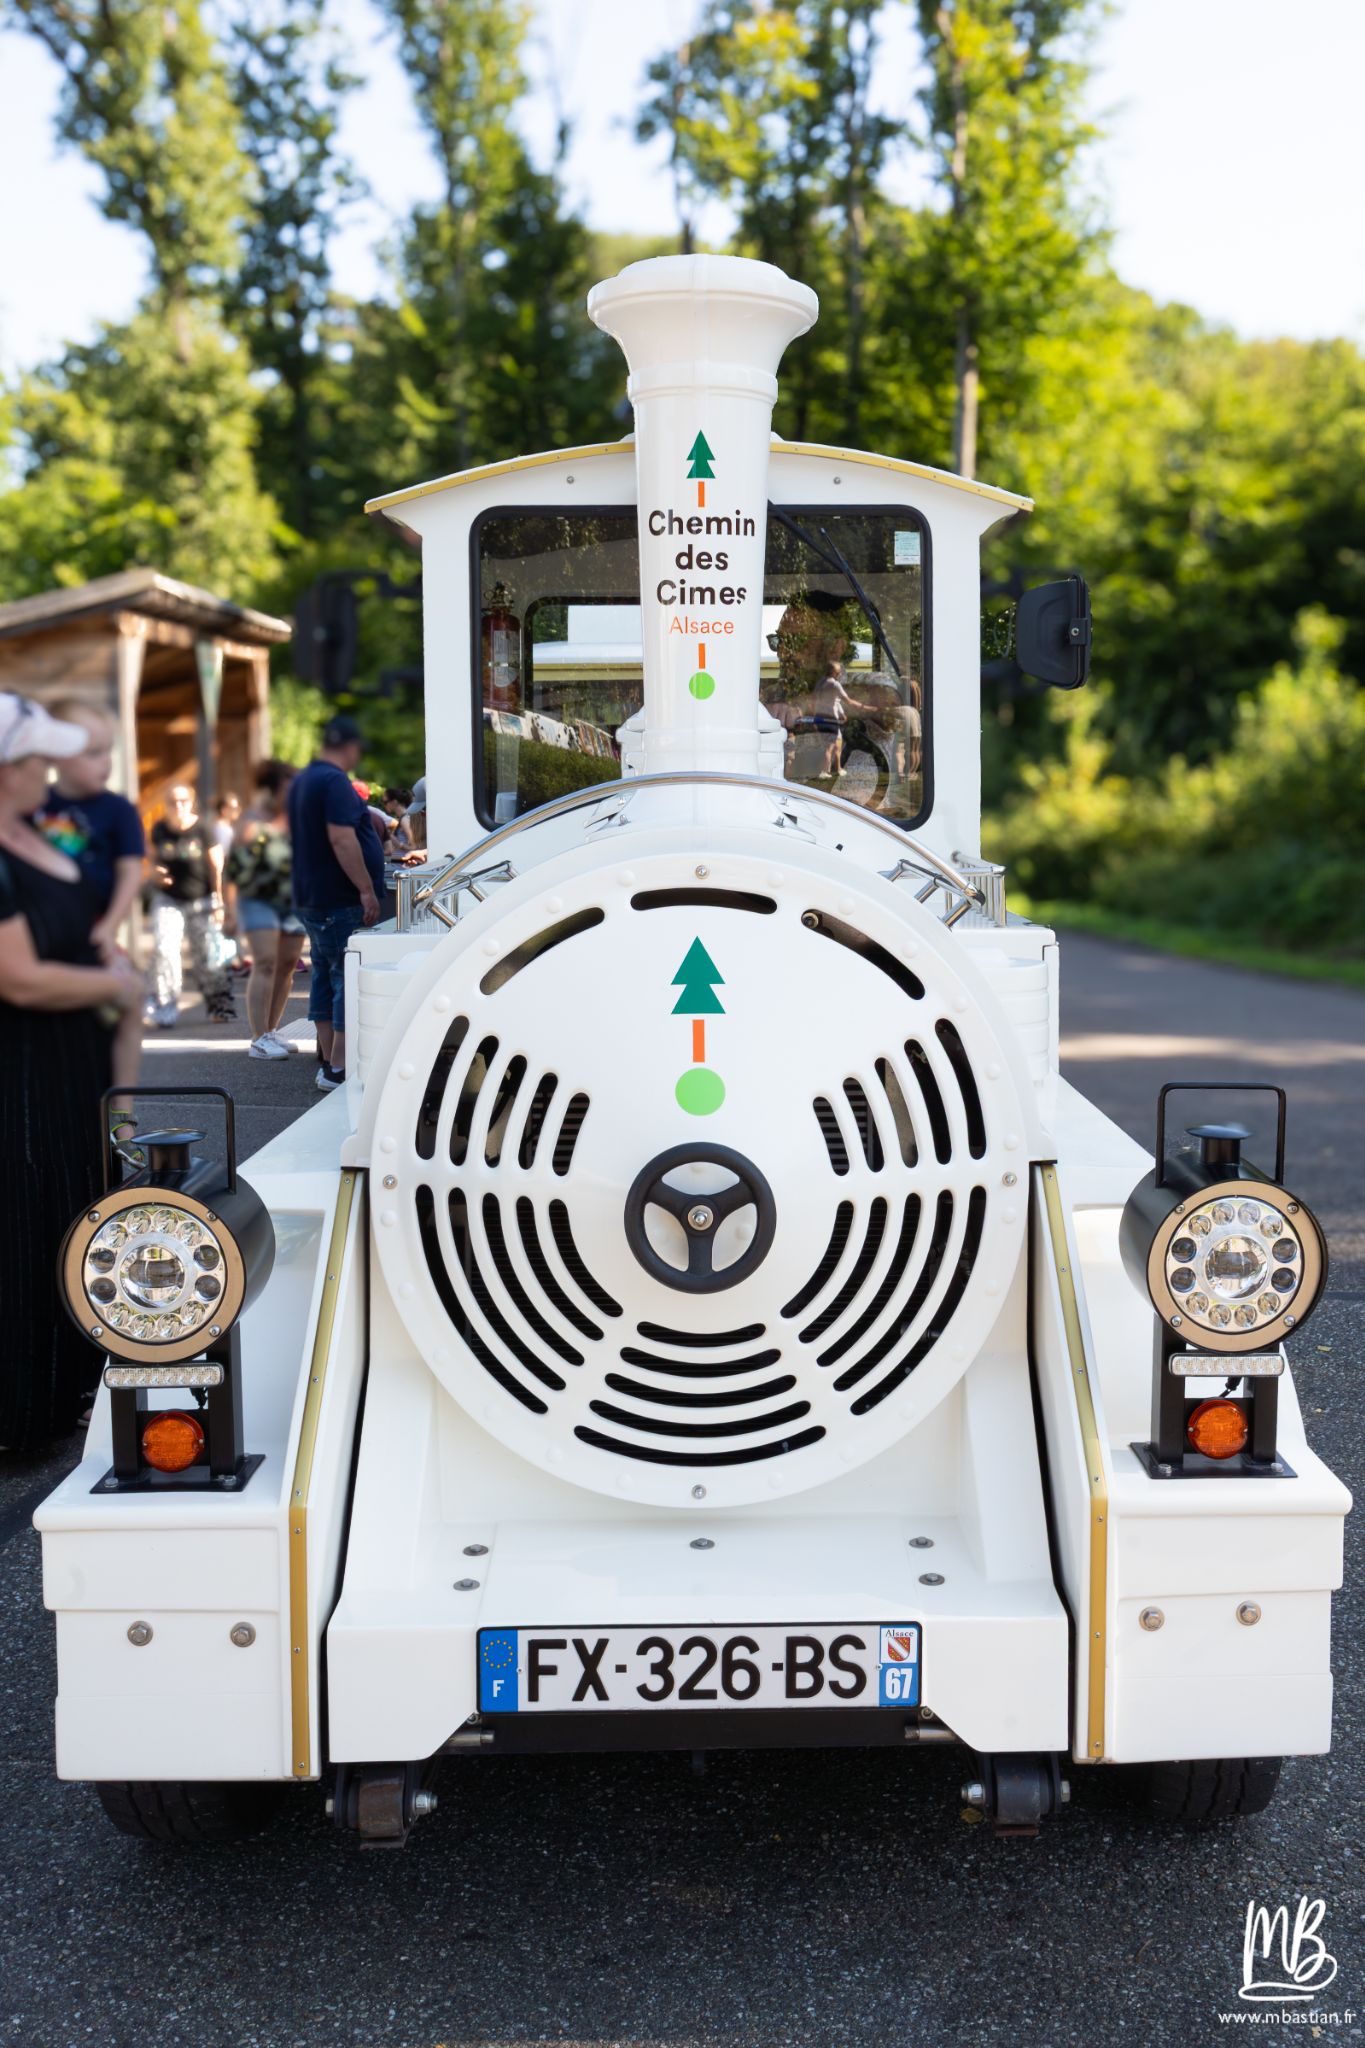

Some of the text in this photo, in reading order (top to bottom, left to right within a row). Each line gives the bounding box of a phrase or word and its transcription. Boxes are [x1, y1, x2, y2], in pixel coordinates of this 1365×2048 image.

[648, 509, 755, 536] Chemin
[675, 544, 729, 571] des
[656, 579, 747, 605] Cimes
[670, 616, 734, 634] Alsace
[885, 1629, 914, 1637] Alsace
[528, 1634, 867, 1702] FX-326-BS
[493, 1679, 504, 1697] F
[886, 1668, 913, 1699] 67
